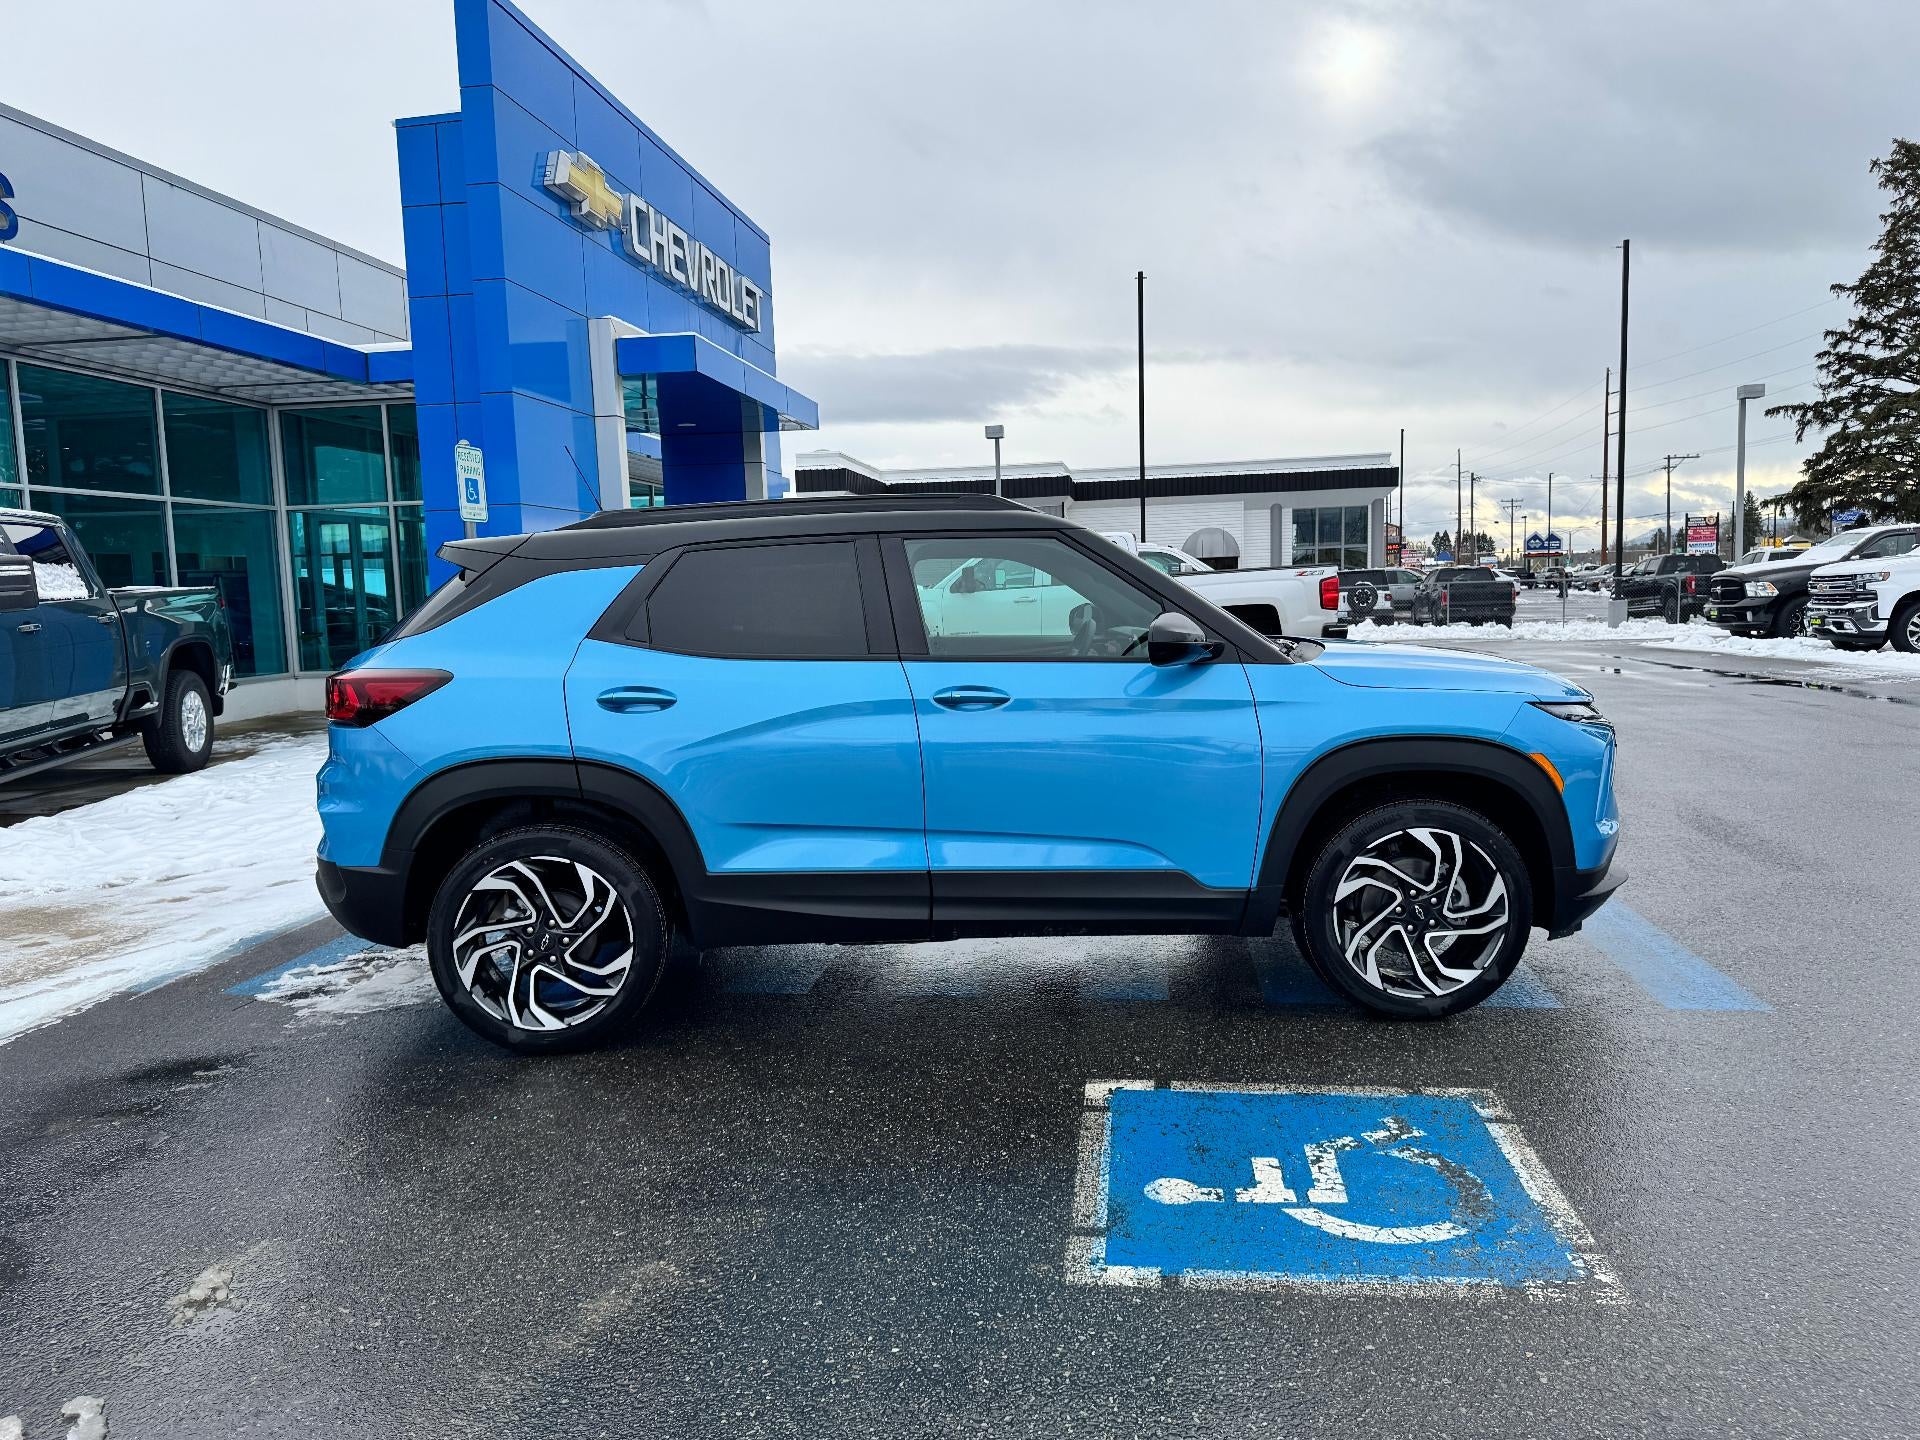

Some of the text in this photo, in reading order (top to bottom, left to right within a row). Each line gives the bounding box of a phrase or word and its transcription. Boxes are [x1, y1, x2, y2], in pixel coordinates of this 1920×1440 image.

[625, 192, 763, 333] CHEVROLET
[460, 464, 481, 476] PARKING
[1836, 511, 1859, 521] Ford
